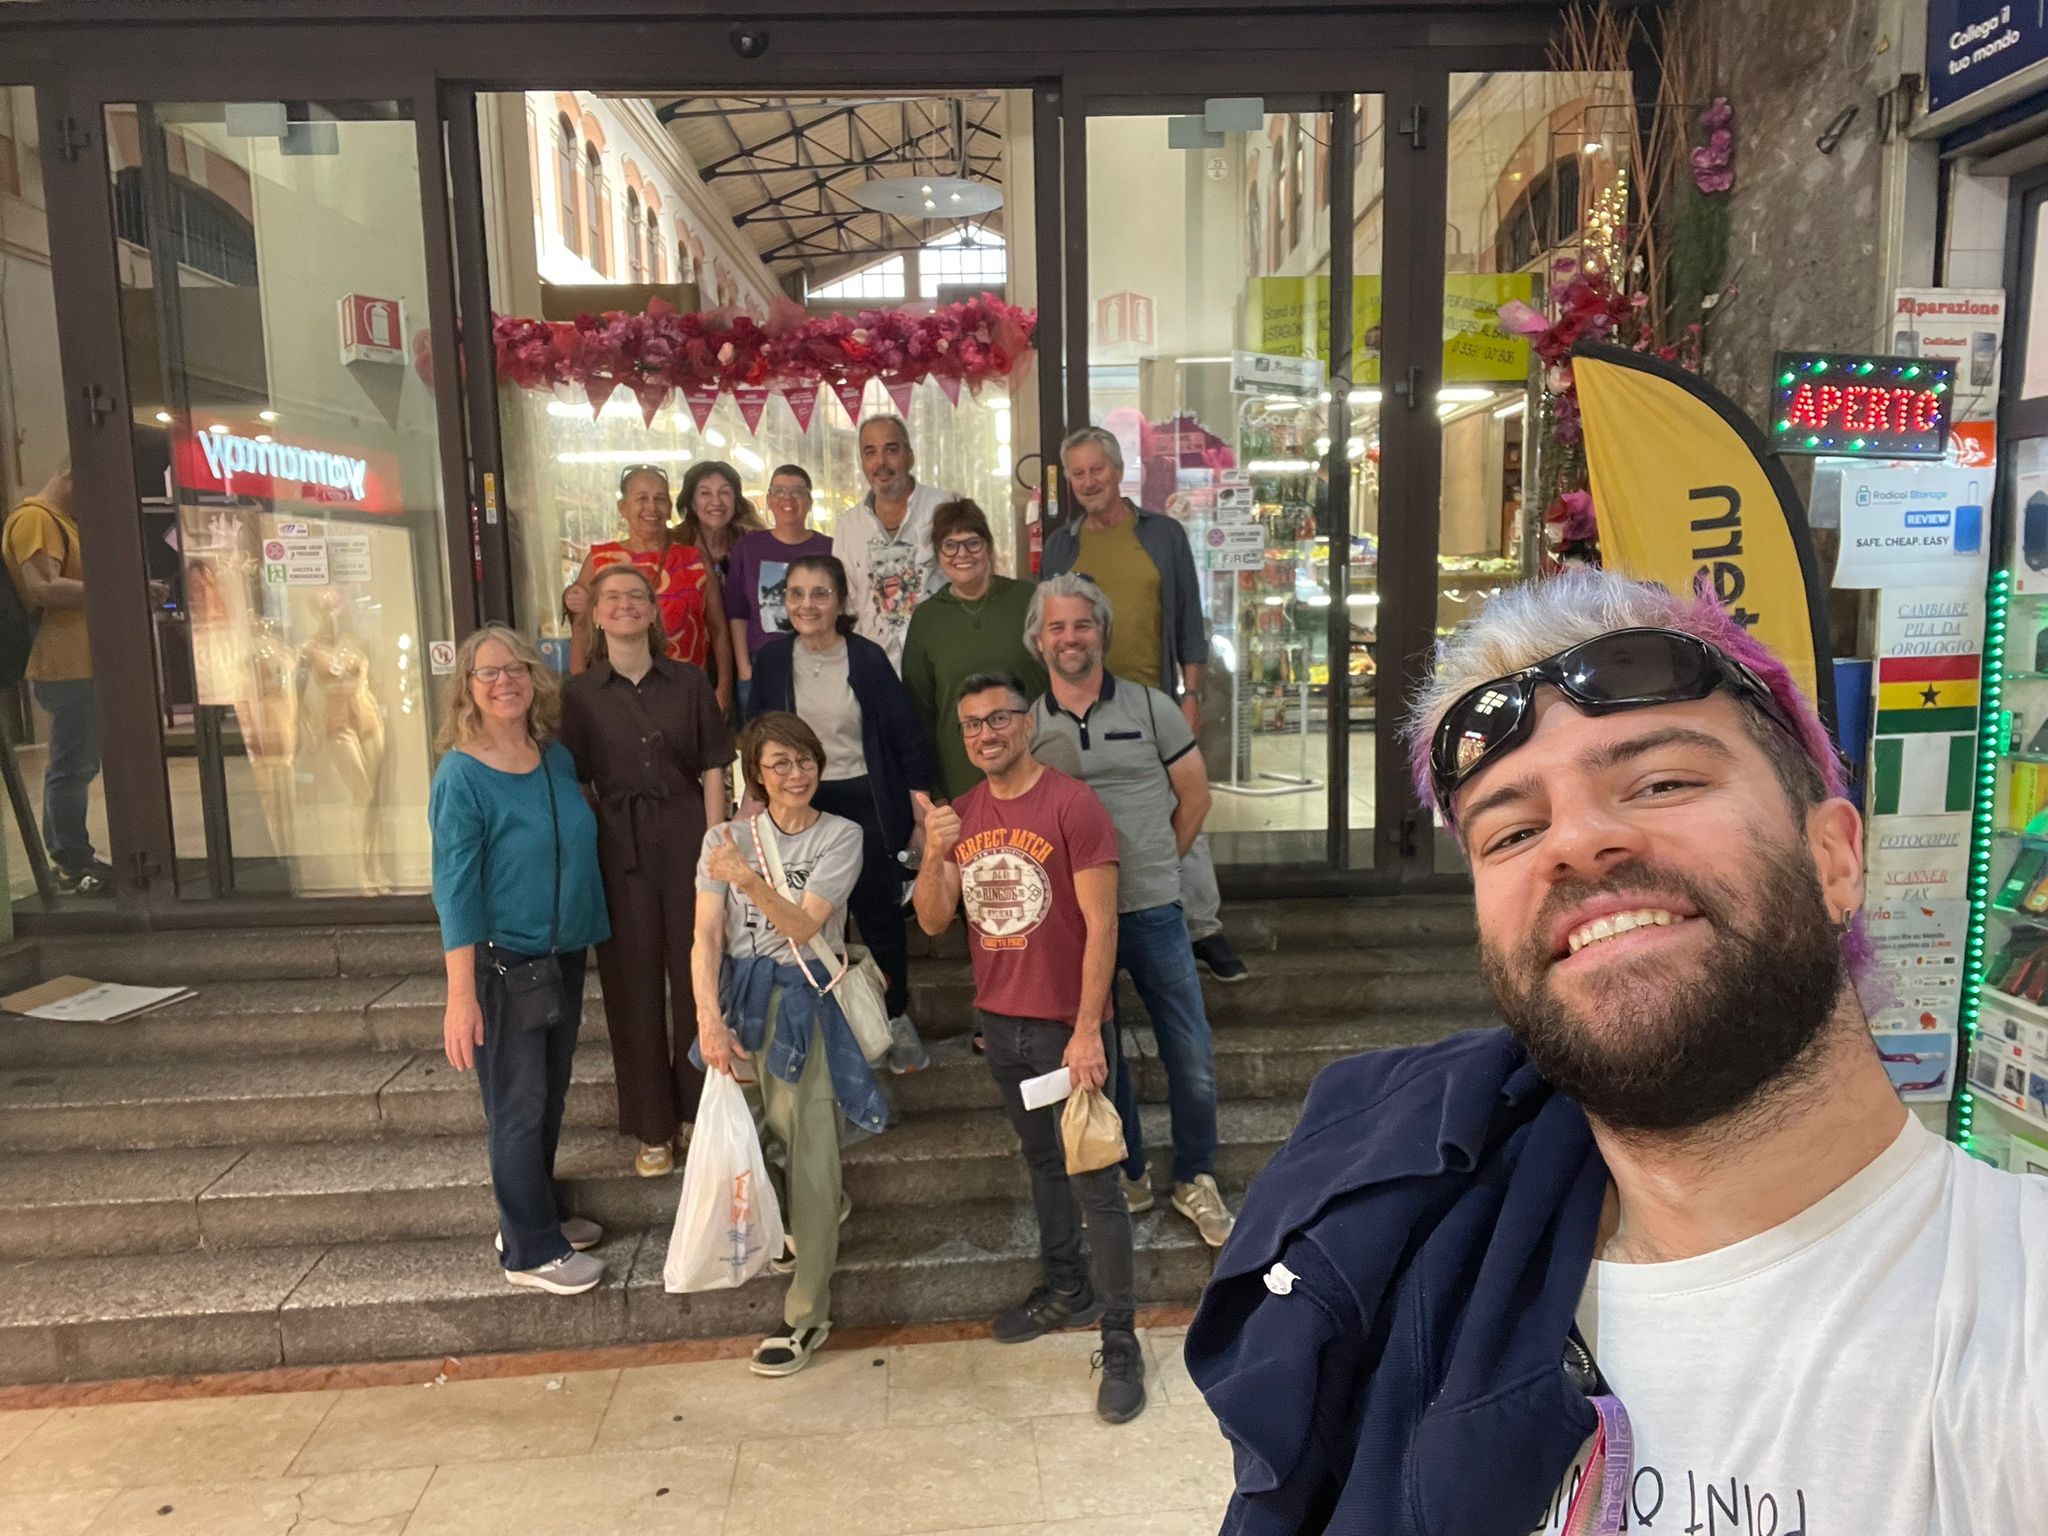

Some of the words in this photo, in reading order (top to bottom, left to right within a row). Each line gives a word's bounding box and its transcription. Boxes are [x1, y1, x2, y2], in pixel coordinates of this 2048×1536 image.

[1949, 16, 1999, 50] Collega
[2000, 5, 2010, 24] il
[1949, 55, 1970, 74] tuo
[1972, 29, 2020, 63] mondo
[1788, 382, 1939, 432] APERTO
[1873, 490, 1908, 499] Radical
[1910, 490, 1948, 500] Storage
[1907, 514, 1949, 524] REVIEW
[1885, 537, 1920, 546] CHEAP.
[1923, 536, 1949, 546] EASY
[1898, 602, 1970, 617] CAMBIARE
[1905, 622, 1935, 636] PILA
[1941, 621, 1962, 635] DA
[1892, 639, 1974, 656] OROLOGIO
[956, 828, 1008, 864] ERFECT
[1880, 833, 1961, 848] FOTOCOPIE
[1886, 870, 1948, 884] SCANNER
[1902, 887, 1930, 900] FAX
